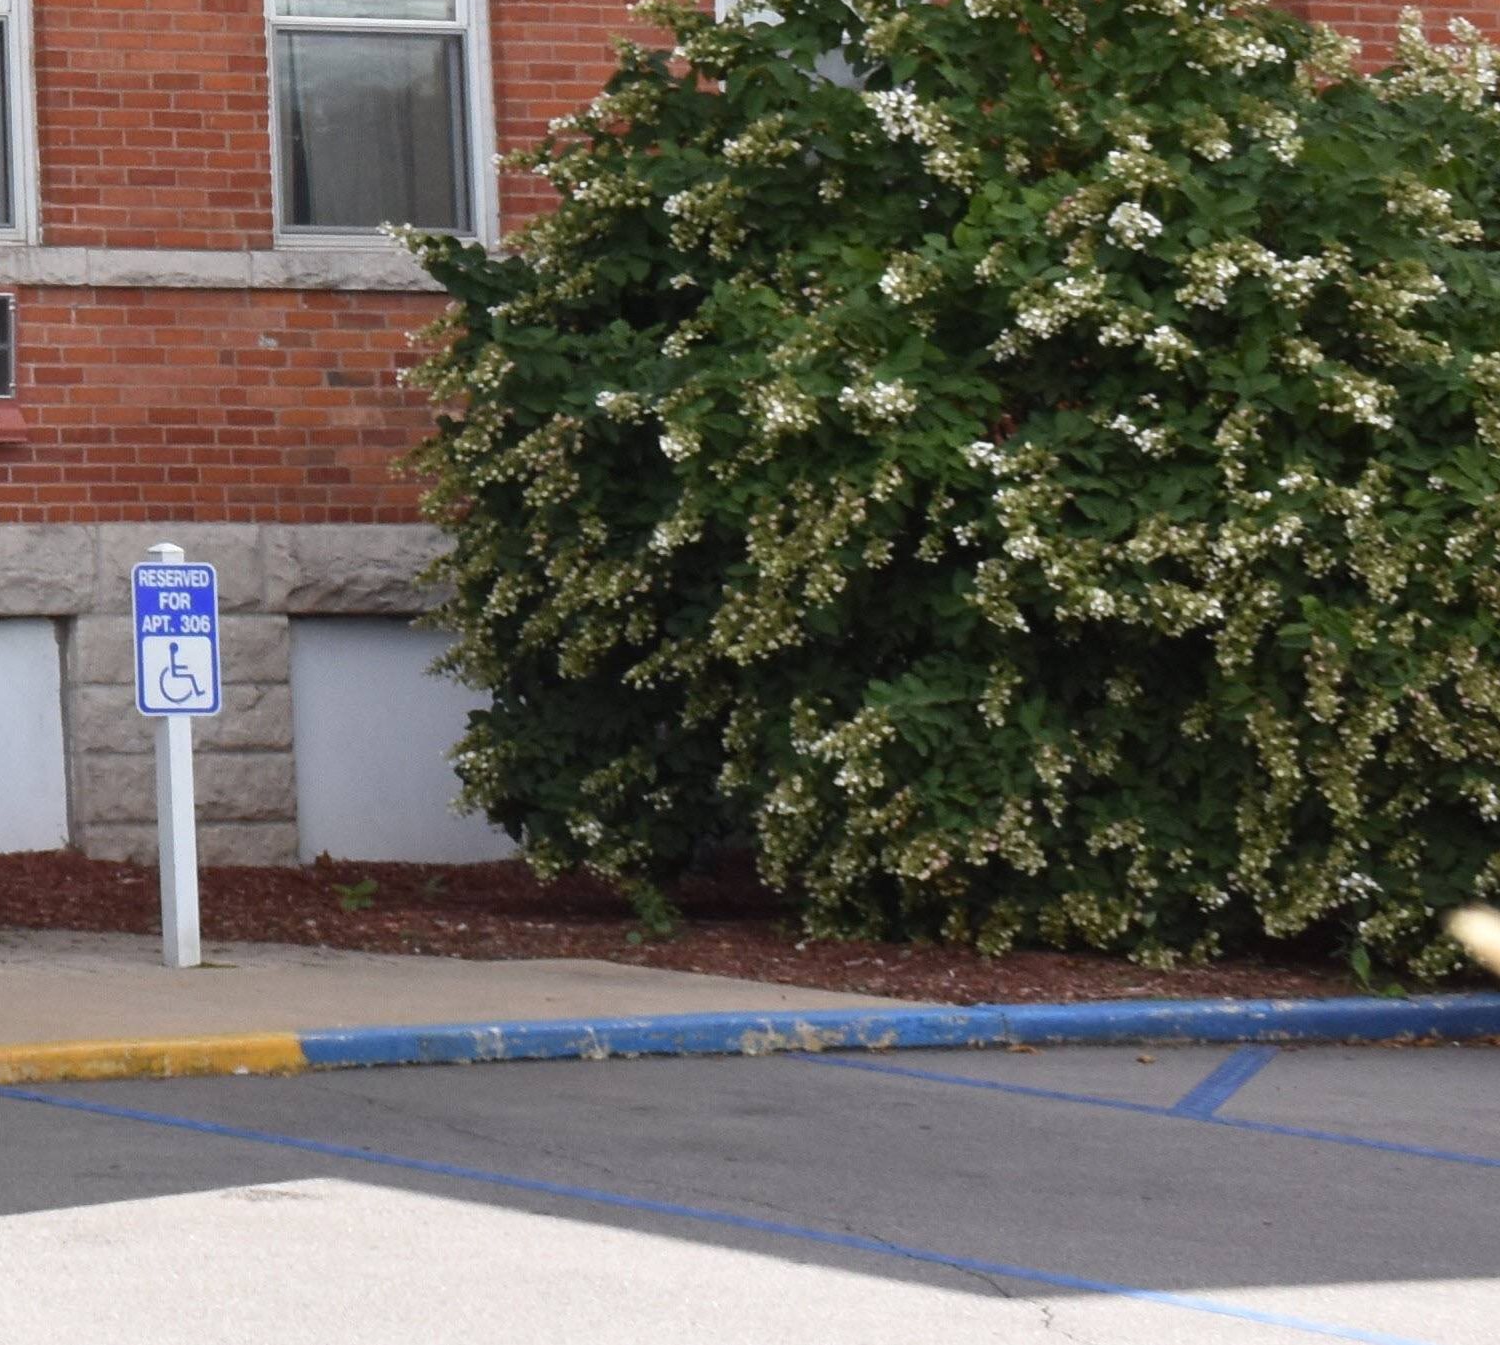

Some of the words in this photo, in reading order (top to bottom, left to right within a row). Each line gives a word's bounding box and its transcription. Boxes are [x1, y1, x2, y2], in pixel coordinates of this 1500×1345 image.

[138, 568, 210, 588] RESERVED
[158, 592, 191, 610] FOR
[141, 615, 175, 633] APT.
[180, 615, 211, 633] 306
